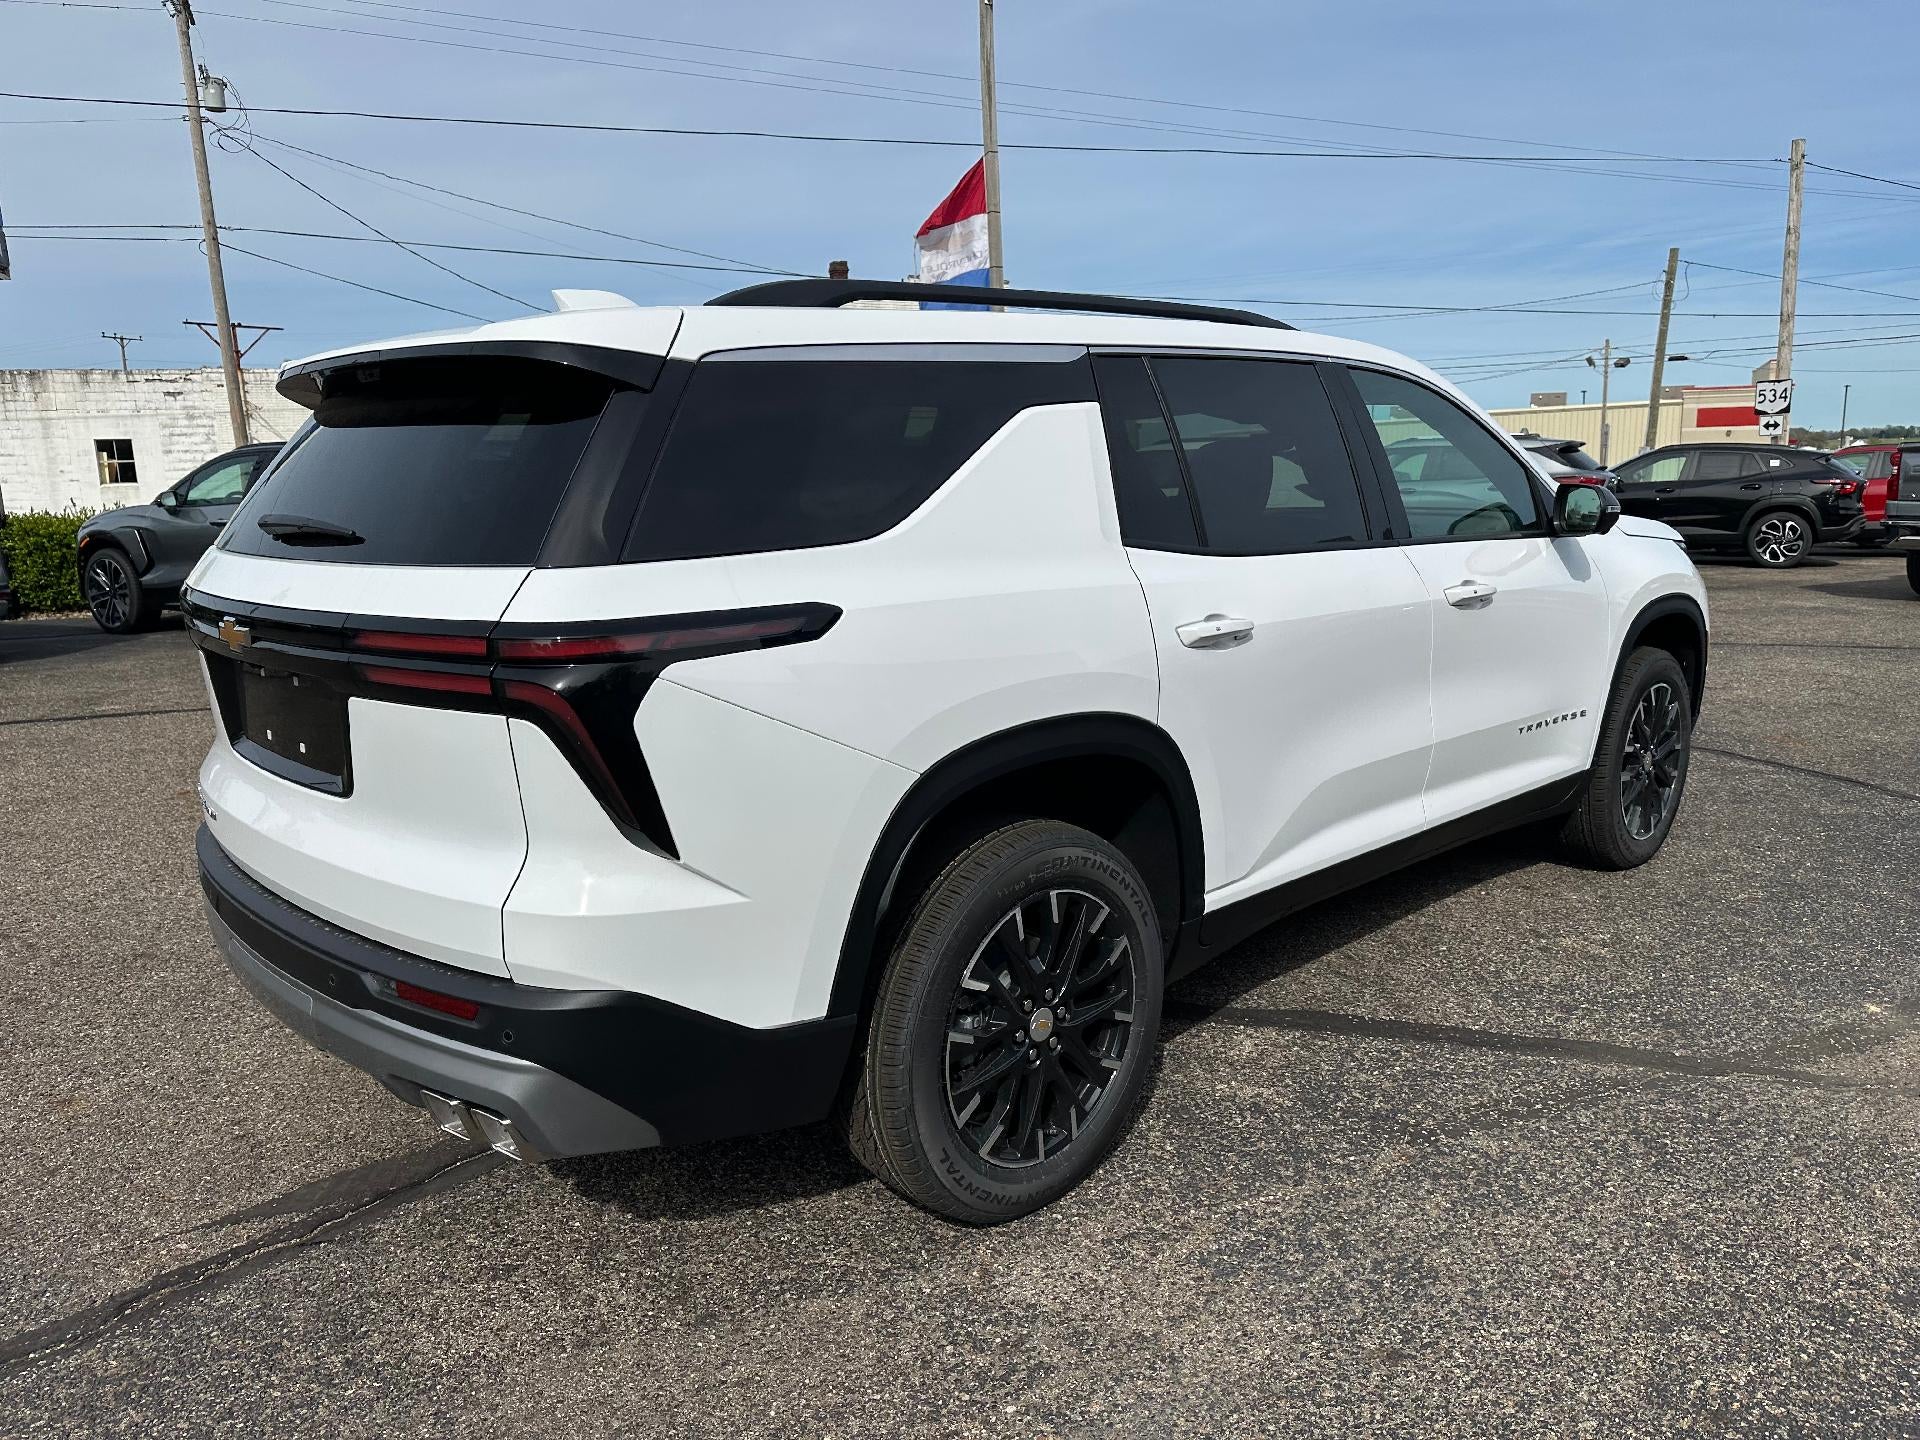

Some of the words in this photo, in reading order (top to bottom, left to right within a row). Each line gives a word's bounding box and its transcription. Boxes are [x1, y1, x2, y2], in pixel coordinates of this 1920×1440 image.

[1757, 387, 1788, 404] 534
[1518, 709, 1587, 735] TRAVERSE
[939, 1146, 1052, 1207] NTINENTAL
